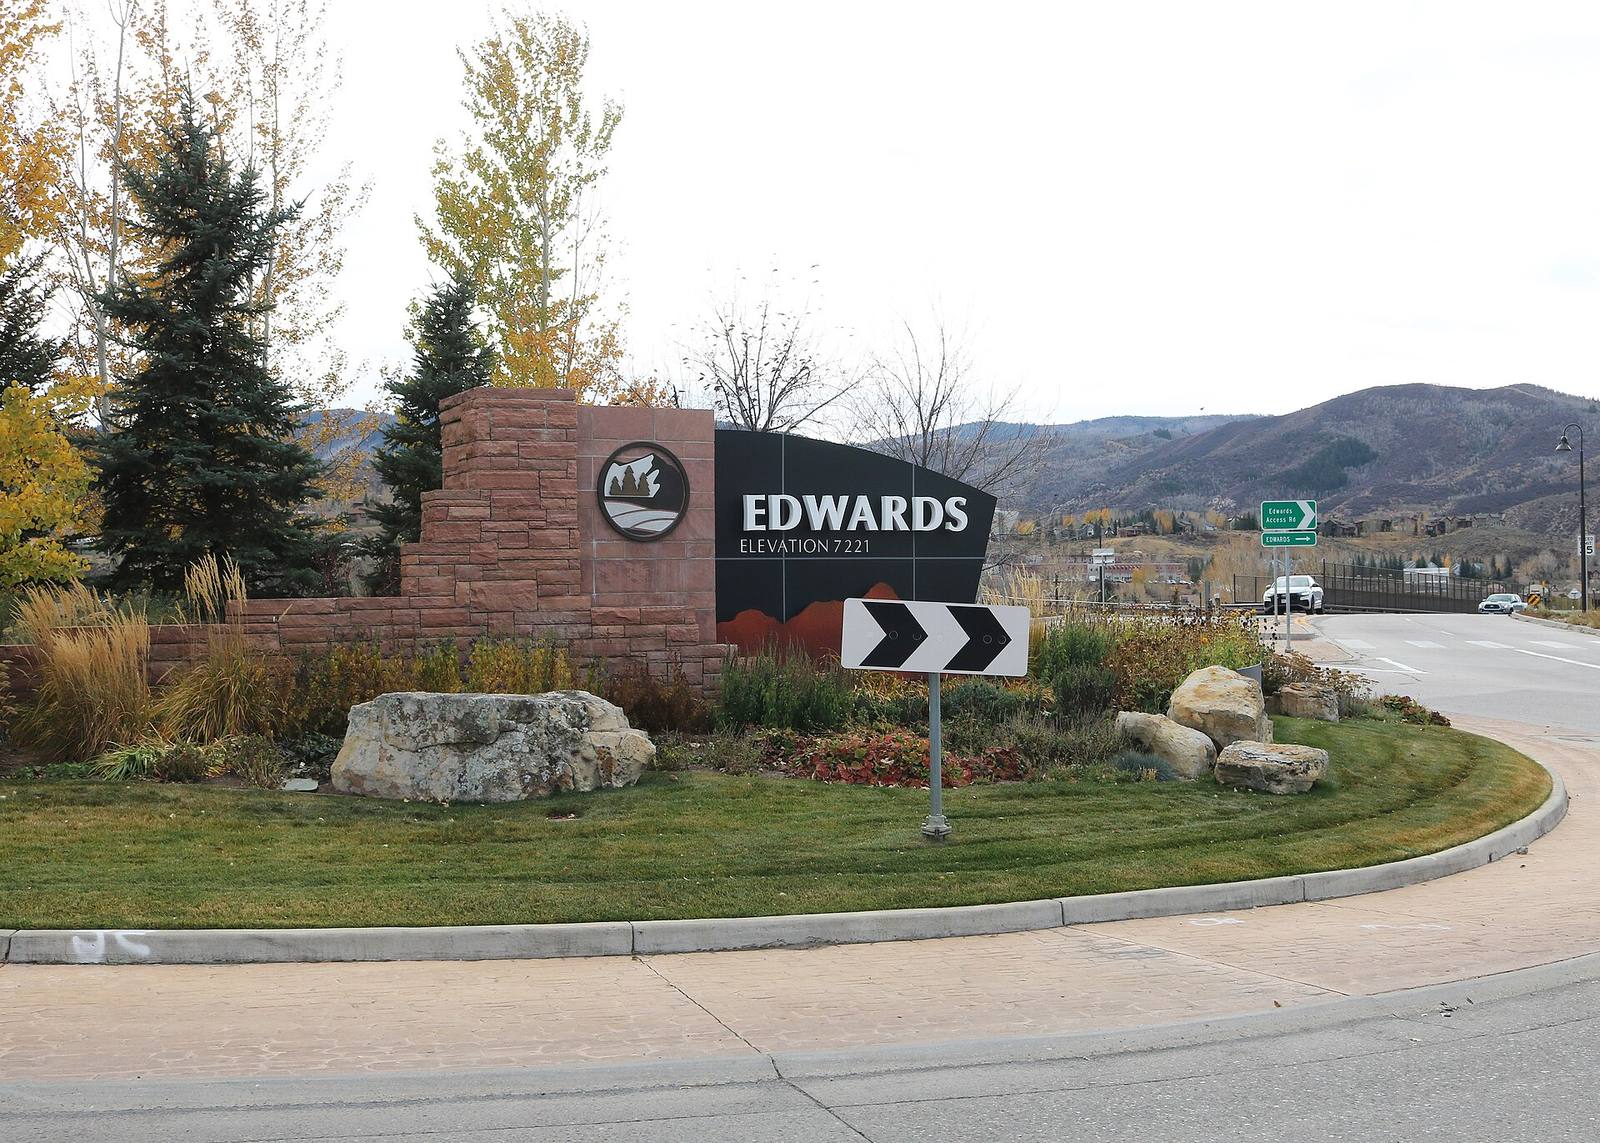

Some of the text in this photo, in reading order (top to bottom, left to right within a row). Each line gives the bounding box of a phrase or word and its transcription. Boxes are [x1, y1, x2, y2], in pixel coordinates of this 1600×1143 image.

[743, 494, 968, 532] EDWARDS
[740, 538, 870, 553] ELEVATION 7221
